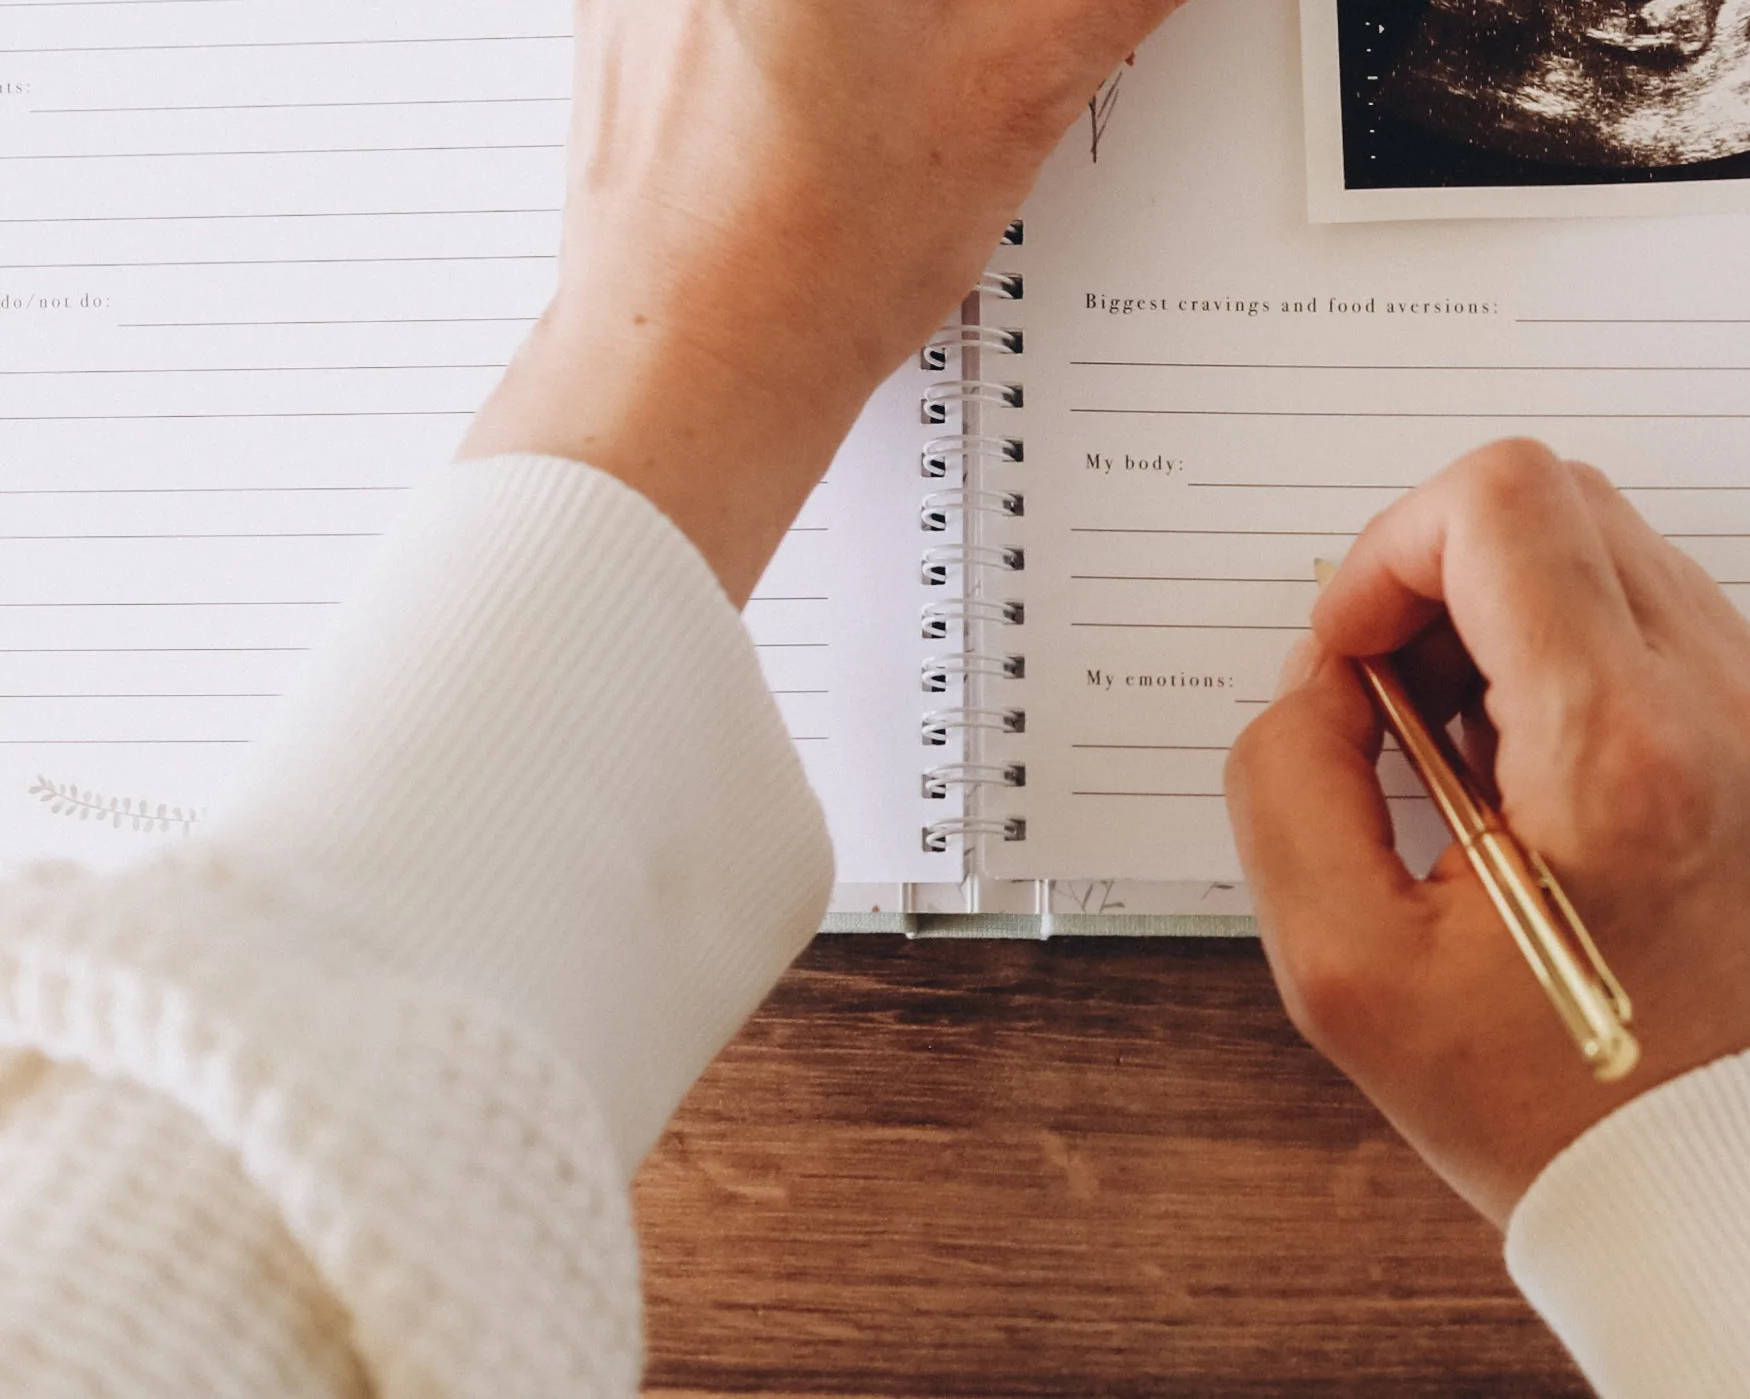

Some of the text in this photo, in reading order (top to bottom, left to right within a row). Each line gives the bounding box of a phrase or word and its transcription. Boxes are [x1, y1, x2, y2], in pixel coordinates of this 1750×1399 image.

[0, 293, 111, 309] do/not do:
[1085, 293, 1500, 316] Biggest cravings and food aversions:
[1085, 453, 1185, 475] My body:
[1086, 669, 1235, 691] My emotions:
